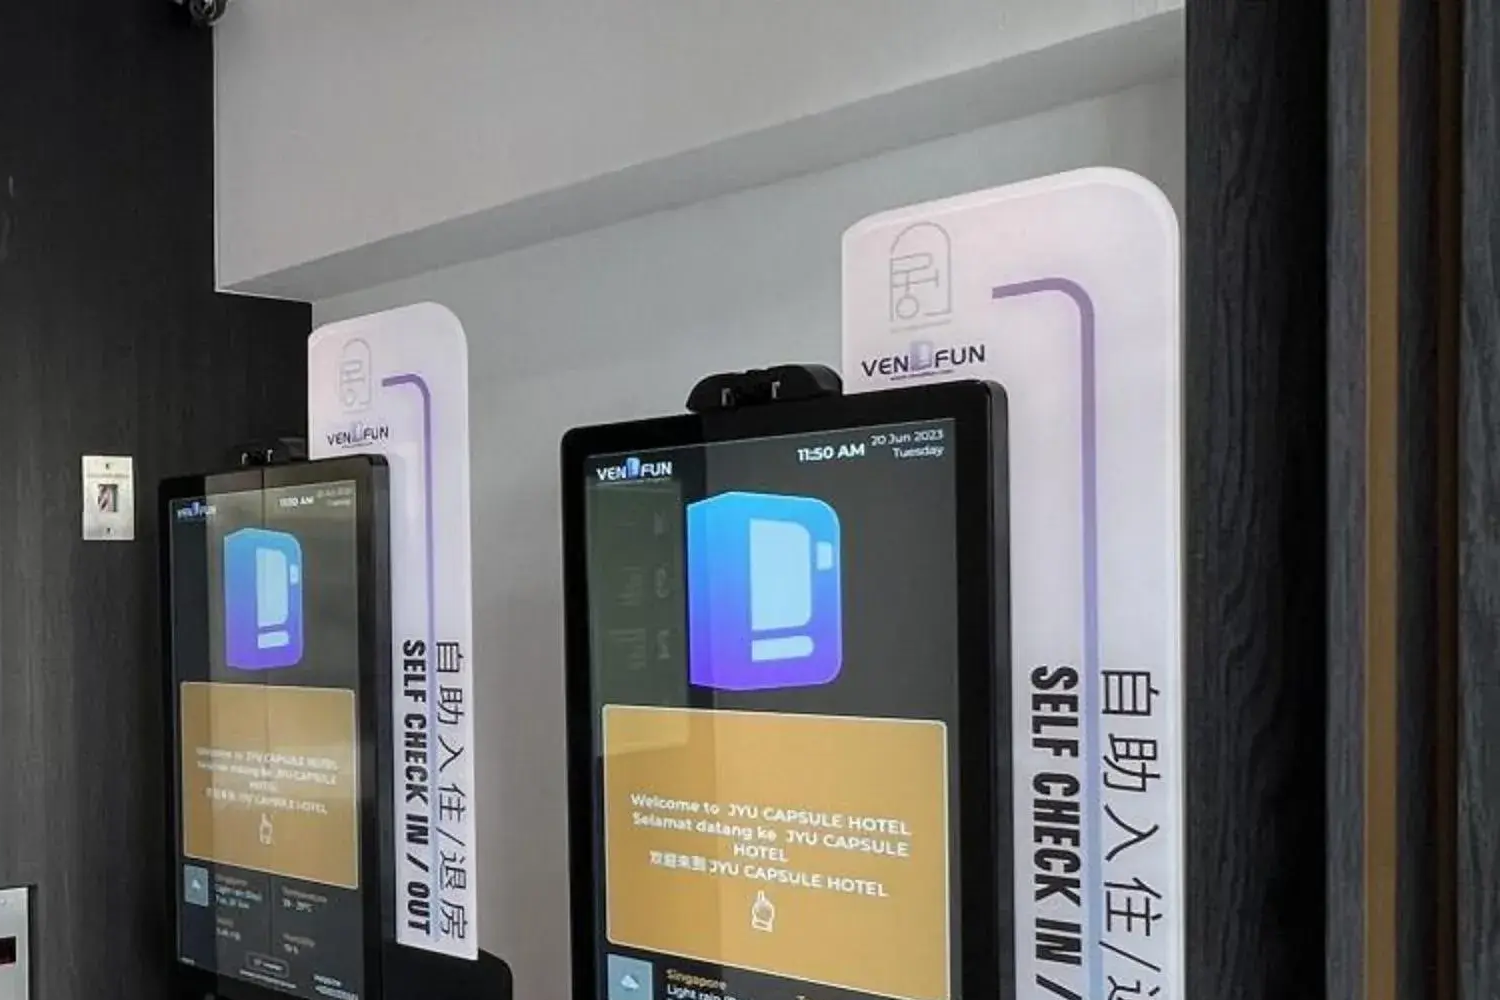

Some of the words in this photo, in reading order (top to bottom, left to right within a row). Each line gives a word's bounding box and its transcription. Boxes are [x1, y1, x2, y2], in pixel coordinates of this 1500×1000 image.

[797, 446, 834, 461] 11:50
[838, 443, 865, 458] AM
[871, 435, 887, 446] 20
[888, 432, 911, 444] Jun
[914, 429, 944, 442] 2023
[892, 446, 944, 459] Tuesday
[403, 639, 426, 703] SELF
[1031, 666, 1079, 758] SELF
[404, 713, 428, 806] CHECK
[405, 813, 429, 845] IN
[630, 793, 700, 813] Welcome
[703, 801, 720, 815] to
[727, 803, 758, 819] JYU
[762, 806, 843, 829] CAPSULE
[847, 815, 912, 836] HOTEL
[632, 811, 693, 832] Selamat
[695, 819, 752, 840] datang
[756, 825, 777, 842] ke
[785, 829, 817, 846] JYU
[822, 833, 910, 858] CAPSULE
[733, 842, 789, 863] HOTEL
[1032, 772, 1082, 907] CHECK
[709, 858, 739, 876] JYU
[743, 864, 822, 888] CAPSULE
[826, 875, 890, 898] HOTEL
[407, 881, 431, 936] OUT
[1035, 917, 1082, 966] IN
[666, 968, 727, 991] Singapore
[667, 984, 697, 999] Light
